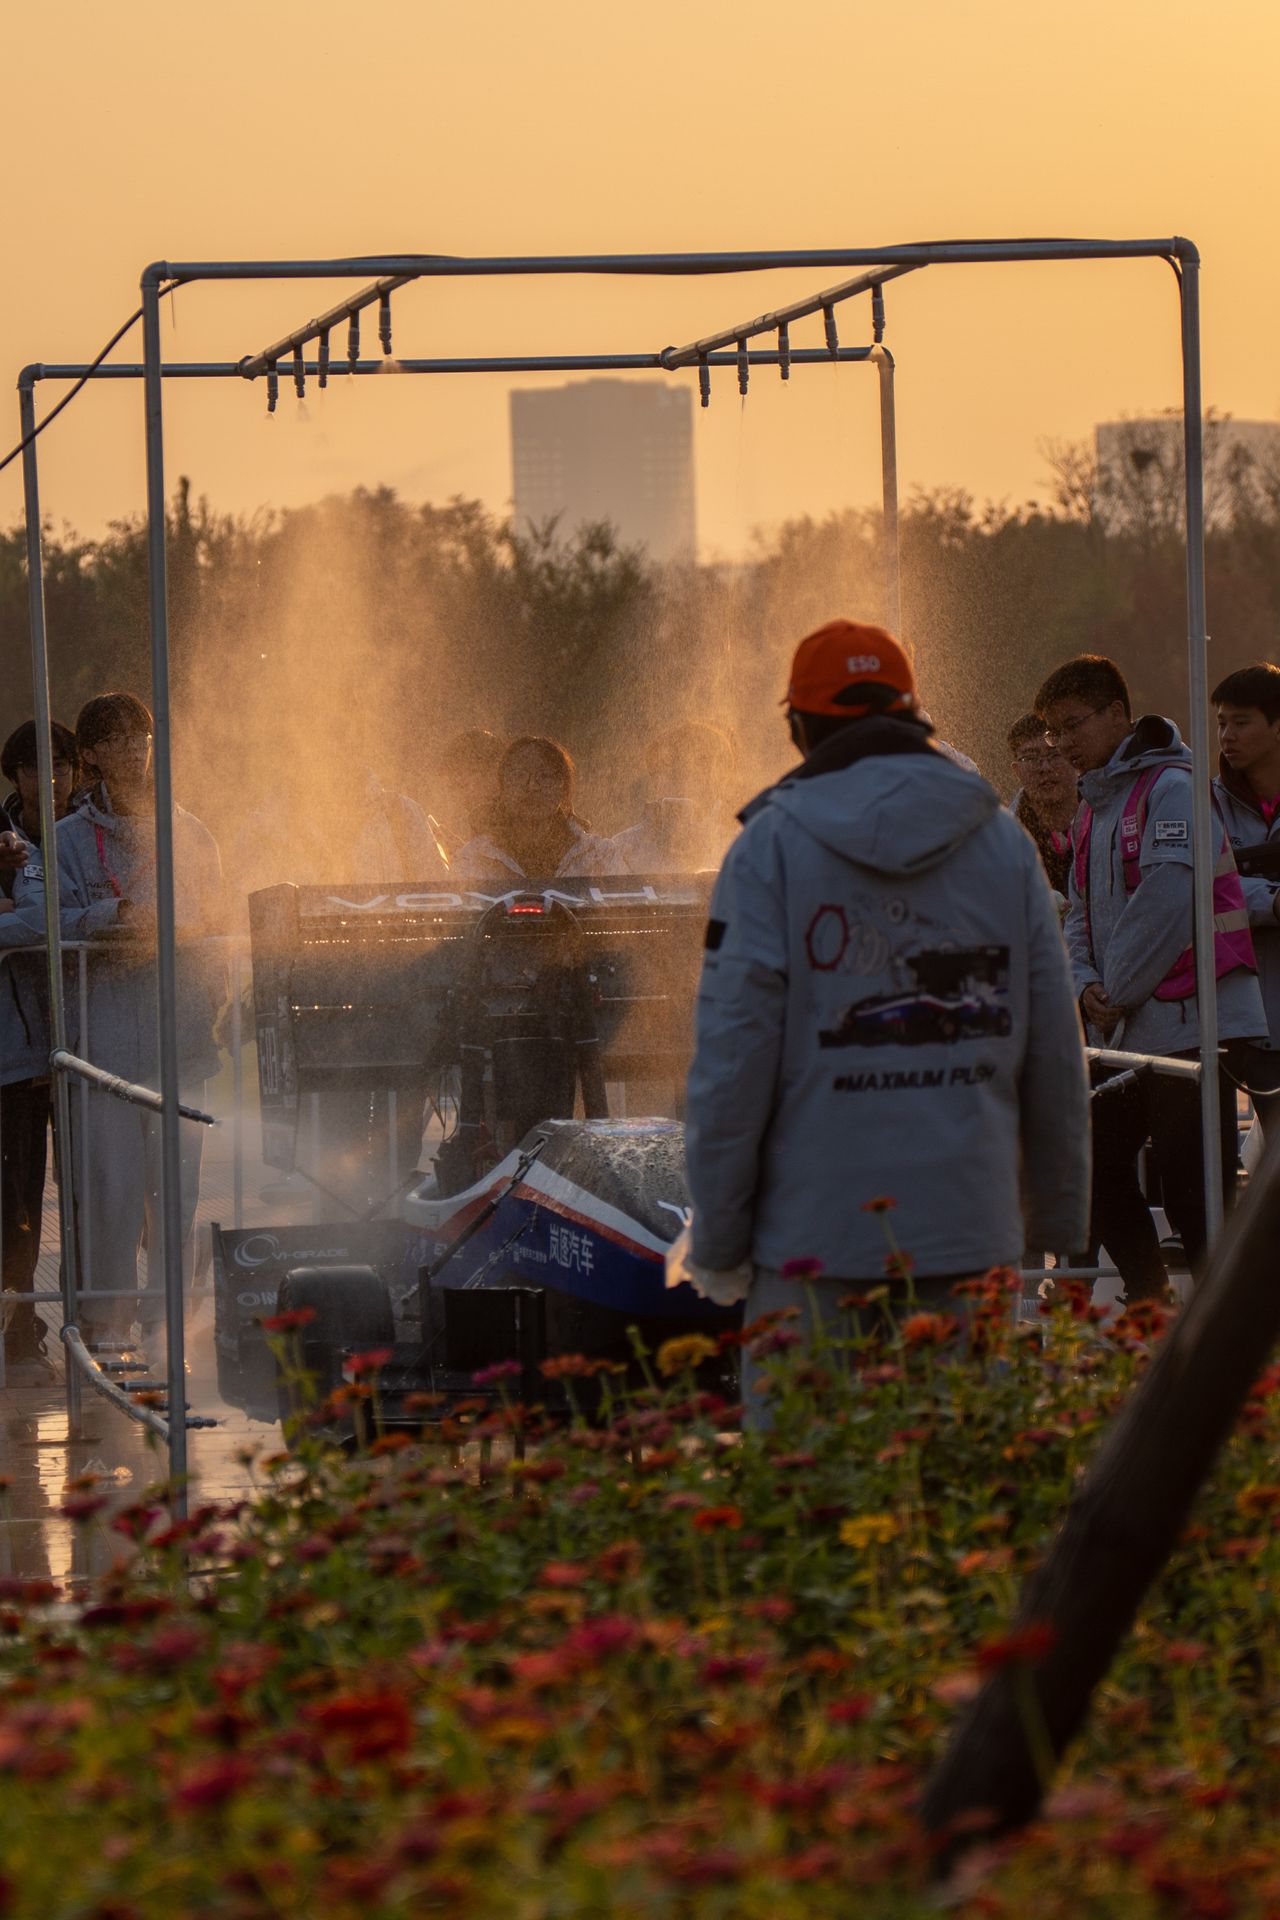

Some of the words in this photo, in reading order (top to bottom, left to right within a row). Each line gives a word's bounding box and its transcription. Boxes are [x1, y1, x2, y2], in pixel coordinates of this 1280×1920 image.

[326, 884, 659, 909] VOYAH
[271, 1247, 350, 1260] VI-GRADE
[549, 1223, 595, 1276] 岚图汽车
